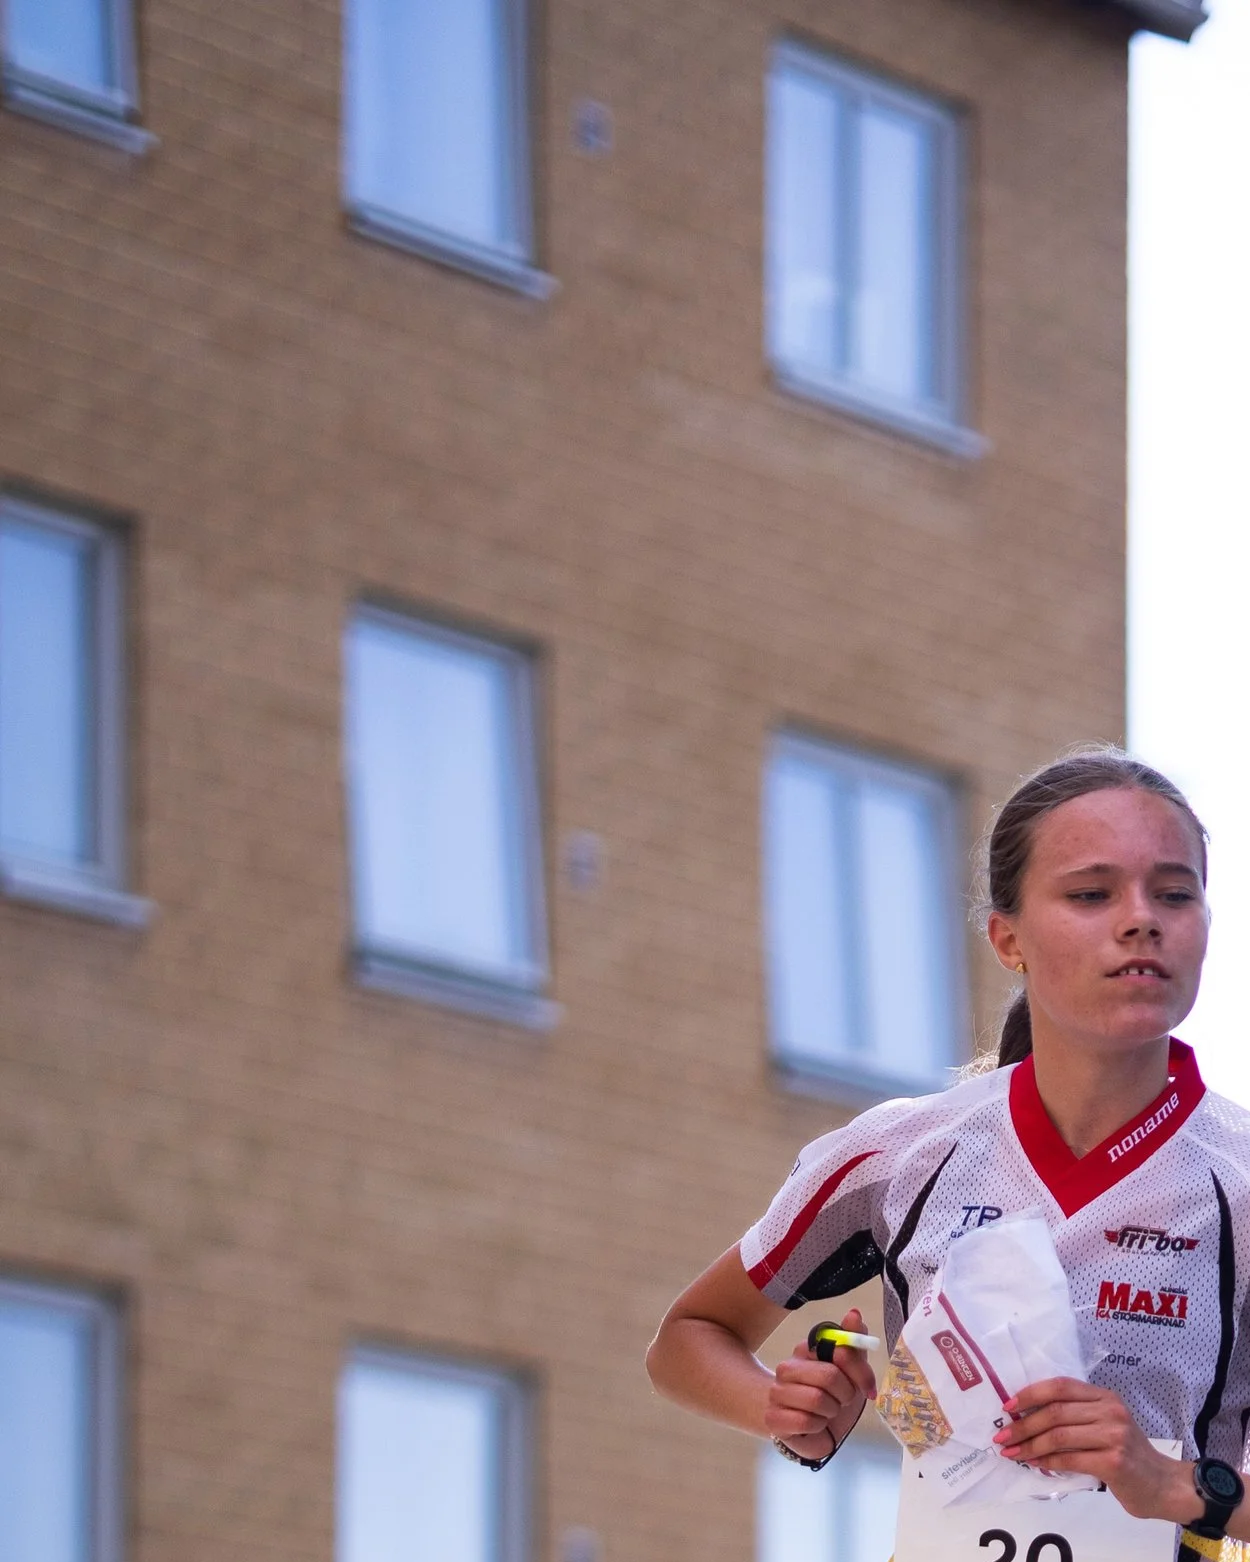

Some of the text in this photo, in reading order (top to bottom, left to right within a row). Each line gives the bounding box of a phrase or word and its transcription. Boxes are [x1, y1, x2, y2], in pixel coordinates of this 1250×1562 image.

[1107, 1092, 1179, 1163] noname
[1097, 1281, 1188, 1319] MAXI
[1112, 1310, 1185, 1328] STORMARKNAD
